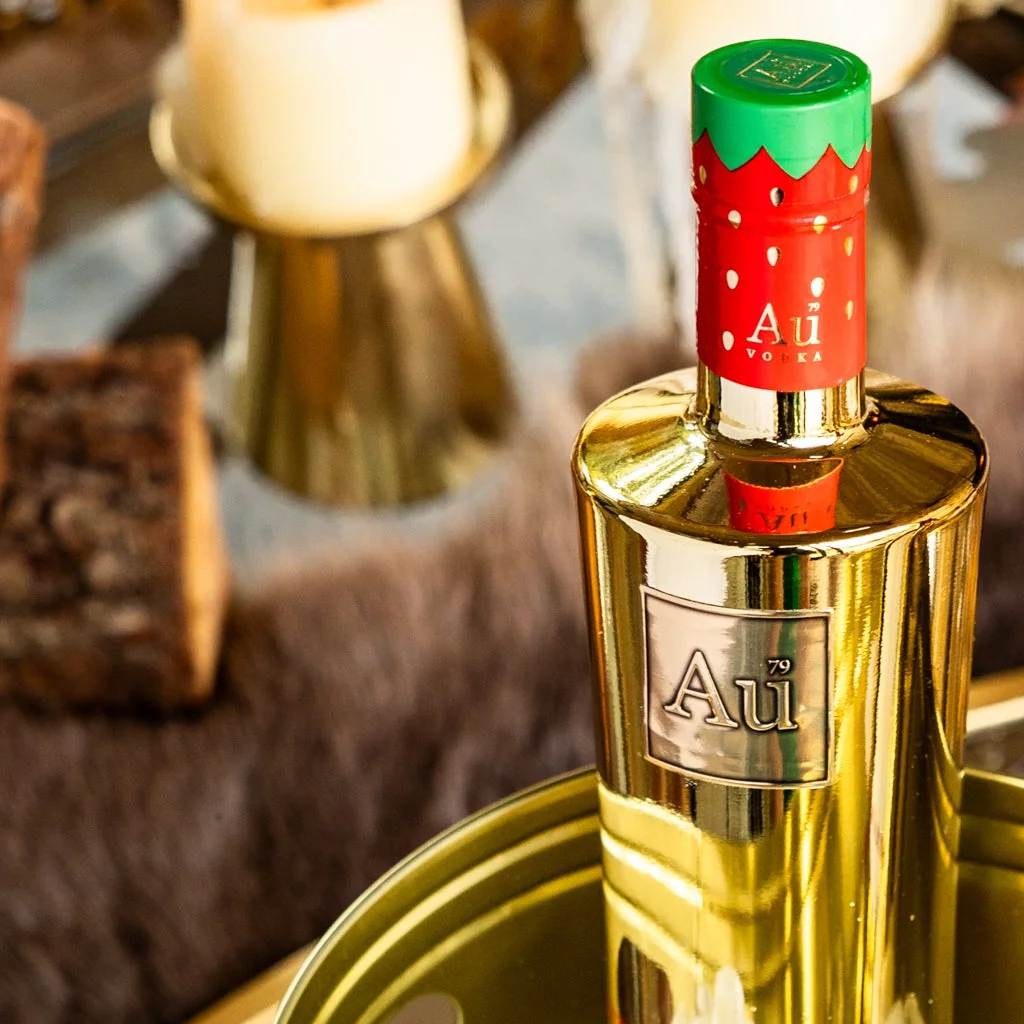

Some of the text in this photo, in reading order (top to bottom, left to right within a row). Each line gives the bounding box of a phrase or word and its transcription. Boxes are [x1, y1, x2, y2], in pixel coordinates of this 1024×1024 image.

[746, 302, 820, 347] Au
[767, 659, 791, 675] 79
[664, 649, 798, 732] Au
